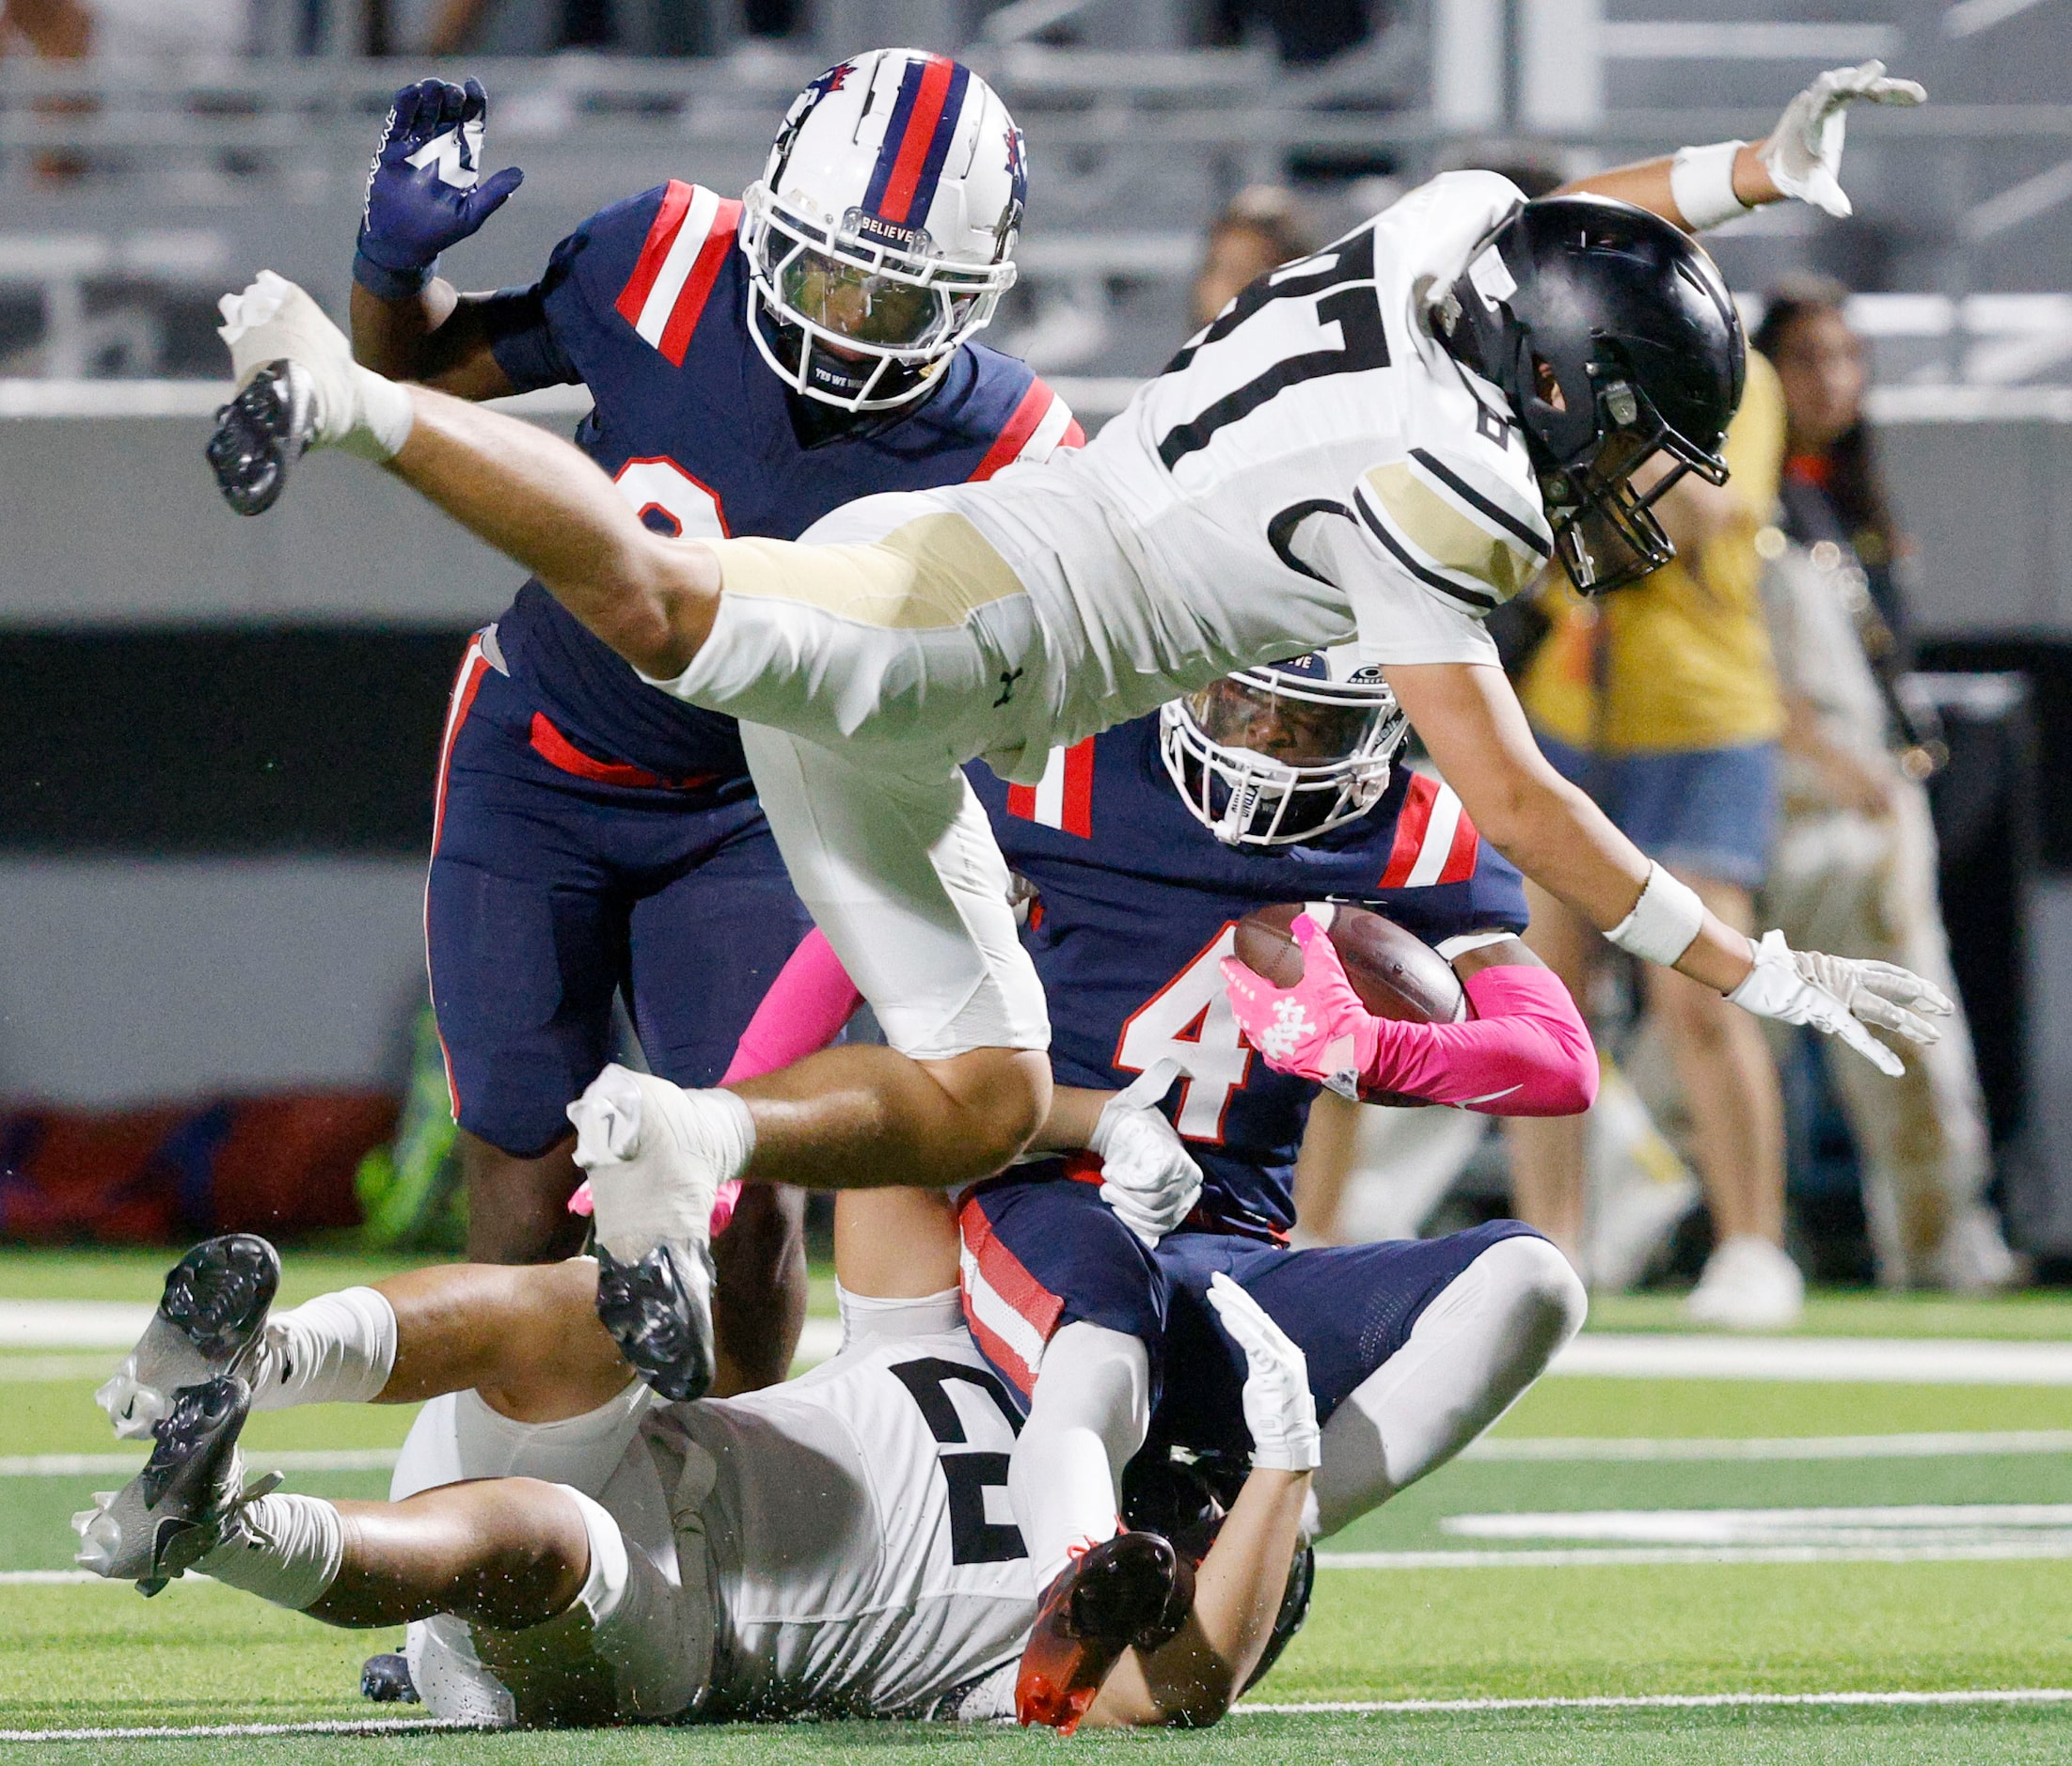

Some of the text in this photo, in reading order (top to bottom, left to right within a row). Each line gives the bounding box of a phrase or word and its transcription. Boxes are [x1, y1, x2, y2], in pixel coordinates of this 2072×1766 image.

[862, 216, 914, 243] BELIEVE
[815, 368, 831, 382] YES
[831, 374, 847, 386] WE
[1112, 919, 1258, 1145] 4
